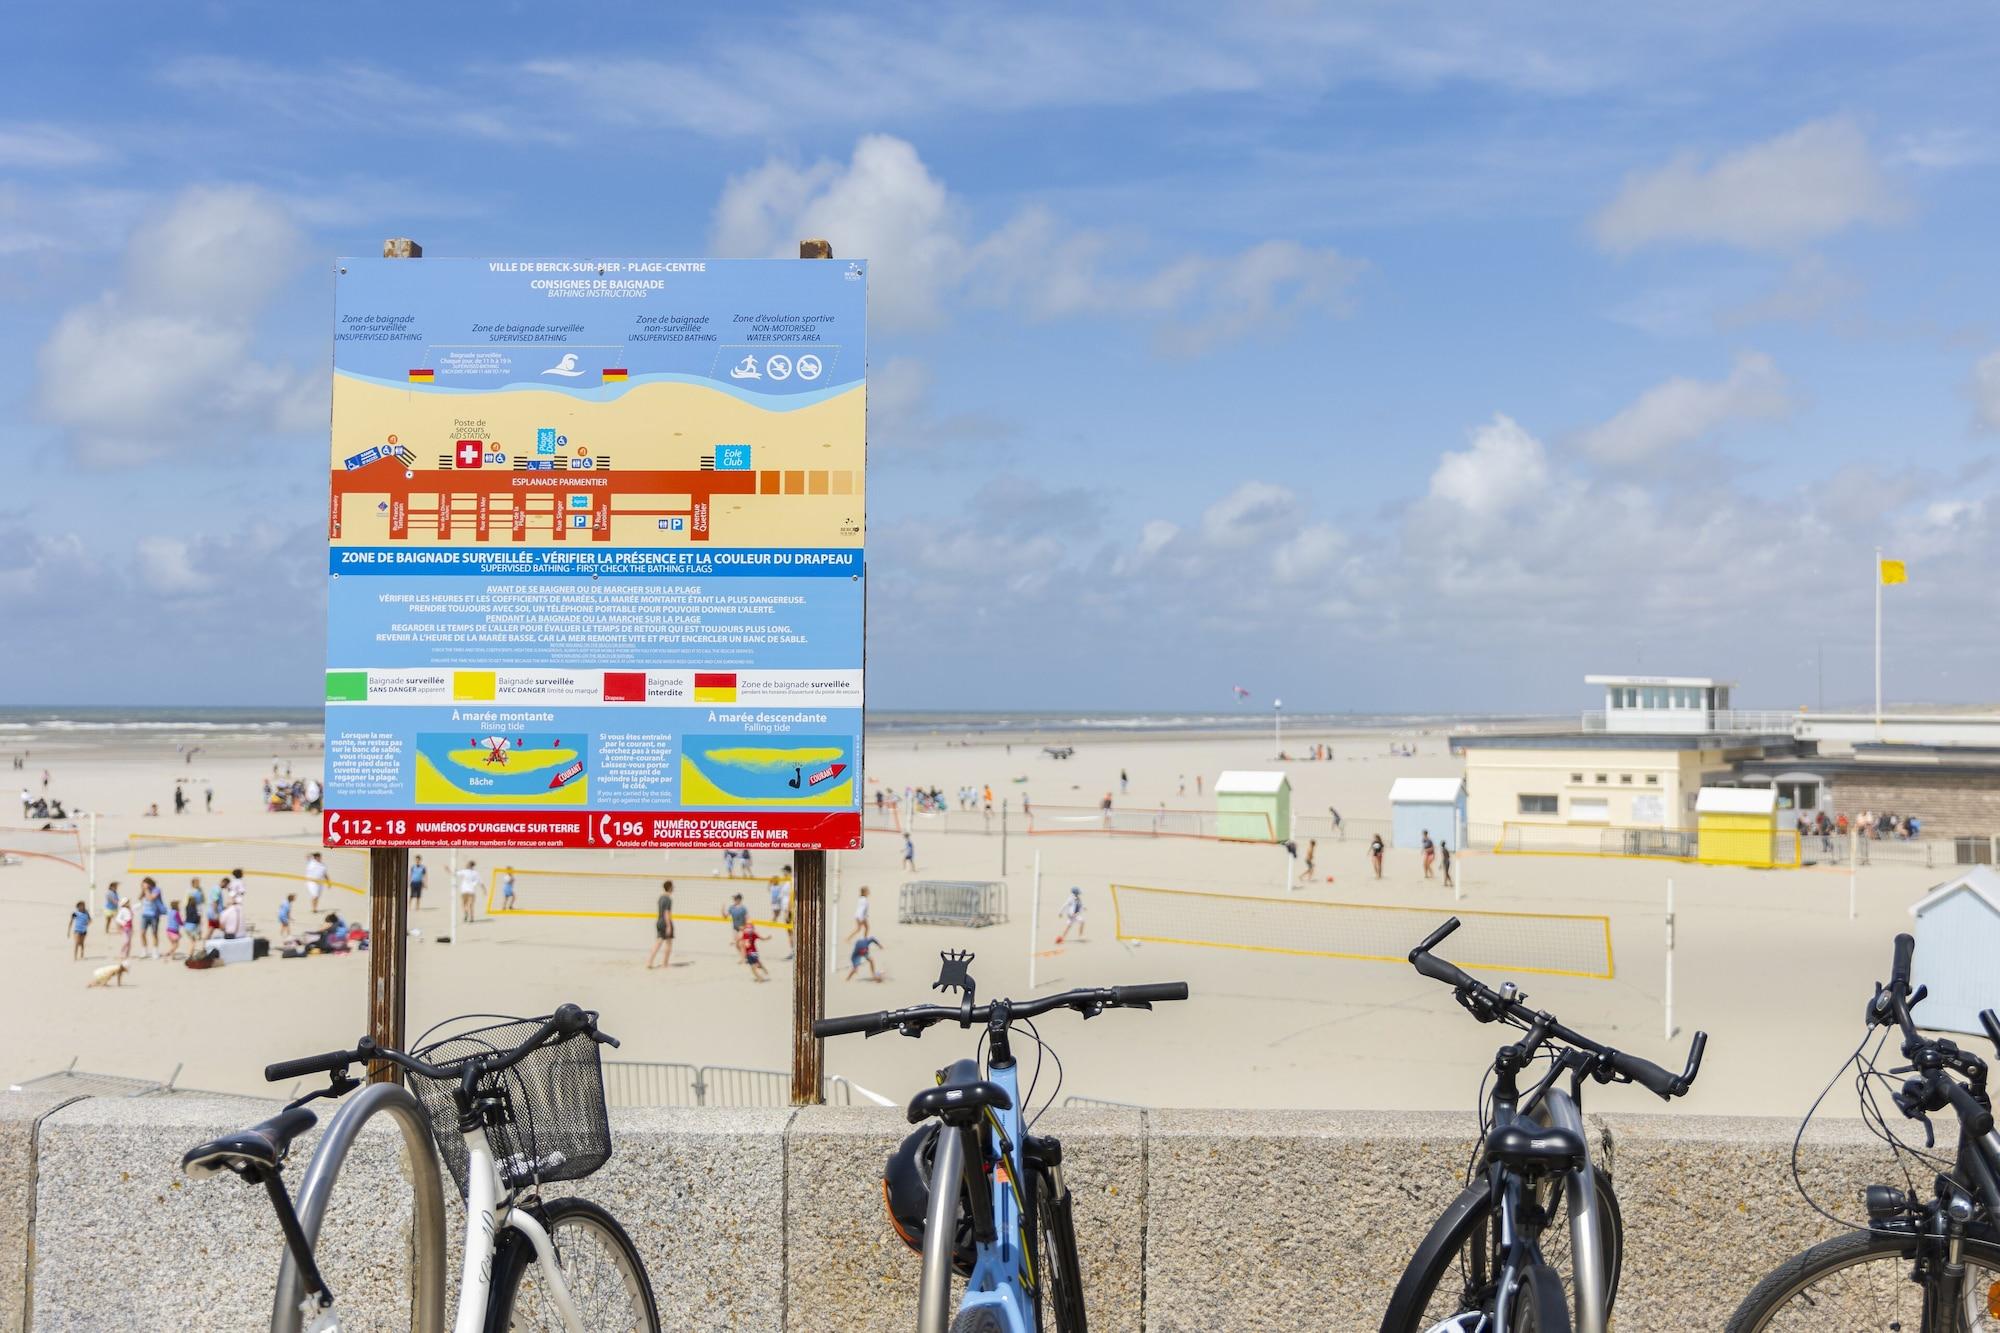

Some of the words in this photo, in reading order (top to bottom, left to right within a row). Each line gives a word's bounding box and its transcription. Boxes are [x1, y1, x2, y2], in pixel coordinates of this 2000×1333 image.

[489, 262, 517, 271] VILLE
[520, 262, 533, 271] DE
[536, 262, 619, 271] BERCK-SUR-MER
[628, 263, 705, 271] PLAGE-CENTRE
[530, 280, 590, 289] CONSIGNES
[593, 280, 608, 289] DE
[609, 280, 664, 289] BAIGNADE
[548, 289, 584, 297] BATHING
[586, 289, 646, 297] INSTRUCTIONS
[342, 314, 362, 322] Zone
[376, 314, 414, 324] baignade
[636, 315, 656, 323] Zone
[658, 315, 668, 323] de
[670, 315, 709, 325] baignade
[733, 314, 753, 322] Zone
[802, 315, 834, 324] sportive
[350, 323, 406, 331] non-surveillée
[506, 324, 544, 333] baignade
[547, 324, 584, 332] surveillée
[334, 333, 389, 342] UNSUPERVISED
[390, 333, 421, 342] BATHING
[724, 449, 741, 458] Eole
[559, 478, 607, 486] PARMENTIER
[342, 552, 374, 562] ZONE
[378, 552, 393, 562] DE
[396, 552, 459, 562] BAIGNADE
[462, 552, 532, 563] SURVEILLÉE
[542, 552, 594, 563] VÉRIFIER
[598, 553, 612, 563] LA
[616, 552, 676, 563] PRÉSENCE
[679, 554, 693, 563] ET
[696, 554, 711, 563] LA
[714, 553, 770, 563] COULEUR
[774, 554, 791, 563] DU
[795, 554, 852, 564] DRAPEAU
[481, 564, 532, 572] SUPERVISED
[532, 564, 569, 572] BATHING
[576, 564, 598, 572] FIRST
[600, 564, 628, 572] CHECK
[629, 564, 645, 572] THE
[648, 564, 684, 572] BATHING
[686, 564, 712, 572] FLAGS
[379, 594, 414, 602] VÉRIFIER
[416, 594, 430, 602] LES
[688, 595, 713, 603] ÉTANT
[727, 595, 748, 603] PLUS
[370, 677, 403, 685] Baignade
[648, 678, 682, 686] Baignade
[452, 709, 459, 720] À
[462, 711, 497, 720] marée
[500, 712, 553, 720] montante
[708, 710, 716, 721] À
[719, 712, 753, 722] marée
[756, 712, 826, 722] descendante
[480, 722, 505, 731] Rising
[744, 723, 771, 733] Falling
[772, 723, 790, 731] tide
[341, 732, 369, 740] Lorsque
[559, 763, 581, 782] COURANT
[811, 767, 834, 783] COURANT
[470, 777, 493, 785] Bâche
[342, 820, 371, 833] 112
[386, 820, 405, 834] 18
[416, 821, 466, 832] NUMÉROS
[528, 824, 547, 832] SUR
[549, 824, 579, 832] TERRE
[614, 822, 642, 835] 196
[654, 818, 698, 830] NUMÉRO
[654, 829, 682, 838] POUR
[684, 830, 700, 838] LES
[703, 830, 748, 838] SECOURS
[750, 830, 764, 838] EN
[766, 830, 787, 838] MER
[344, 839, 368, 847] Outside
[368, 838, 376, 847] of
[376, 839, 386, 847] the
[388, 839, 420, 847] supervised
[450, 839, 461, 848] call
[461, 840, 479, 848] these
[479, 840, 506, 848] numbers
[506, 839, 516, 848] for
[546, 840, 562, 848] earth
